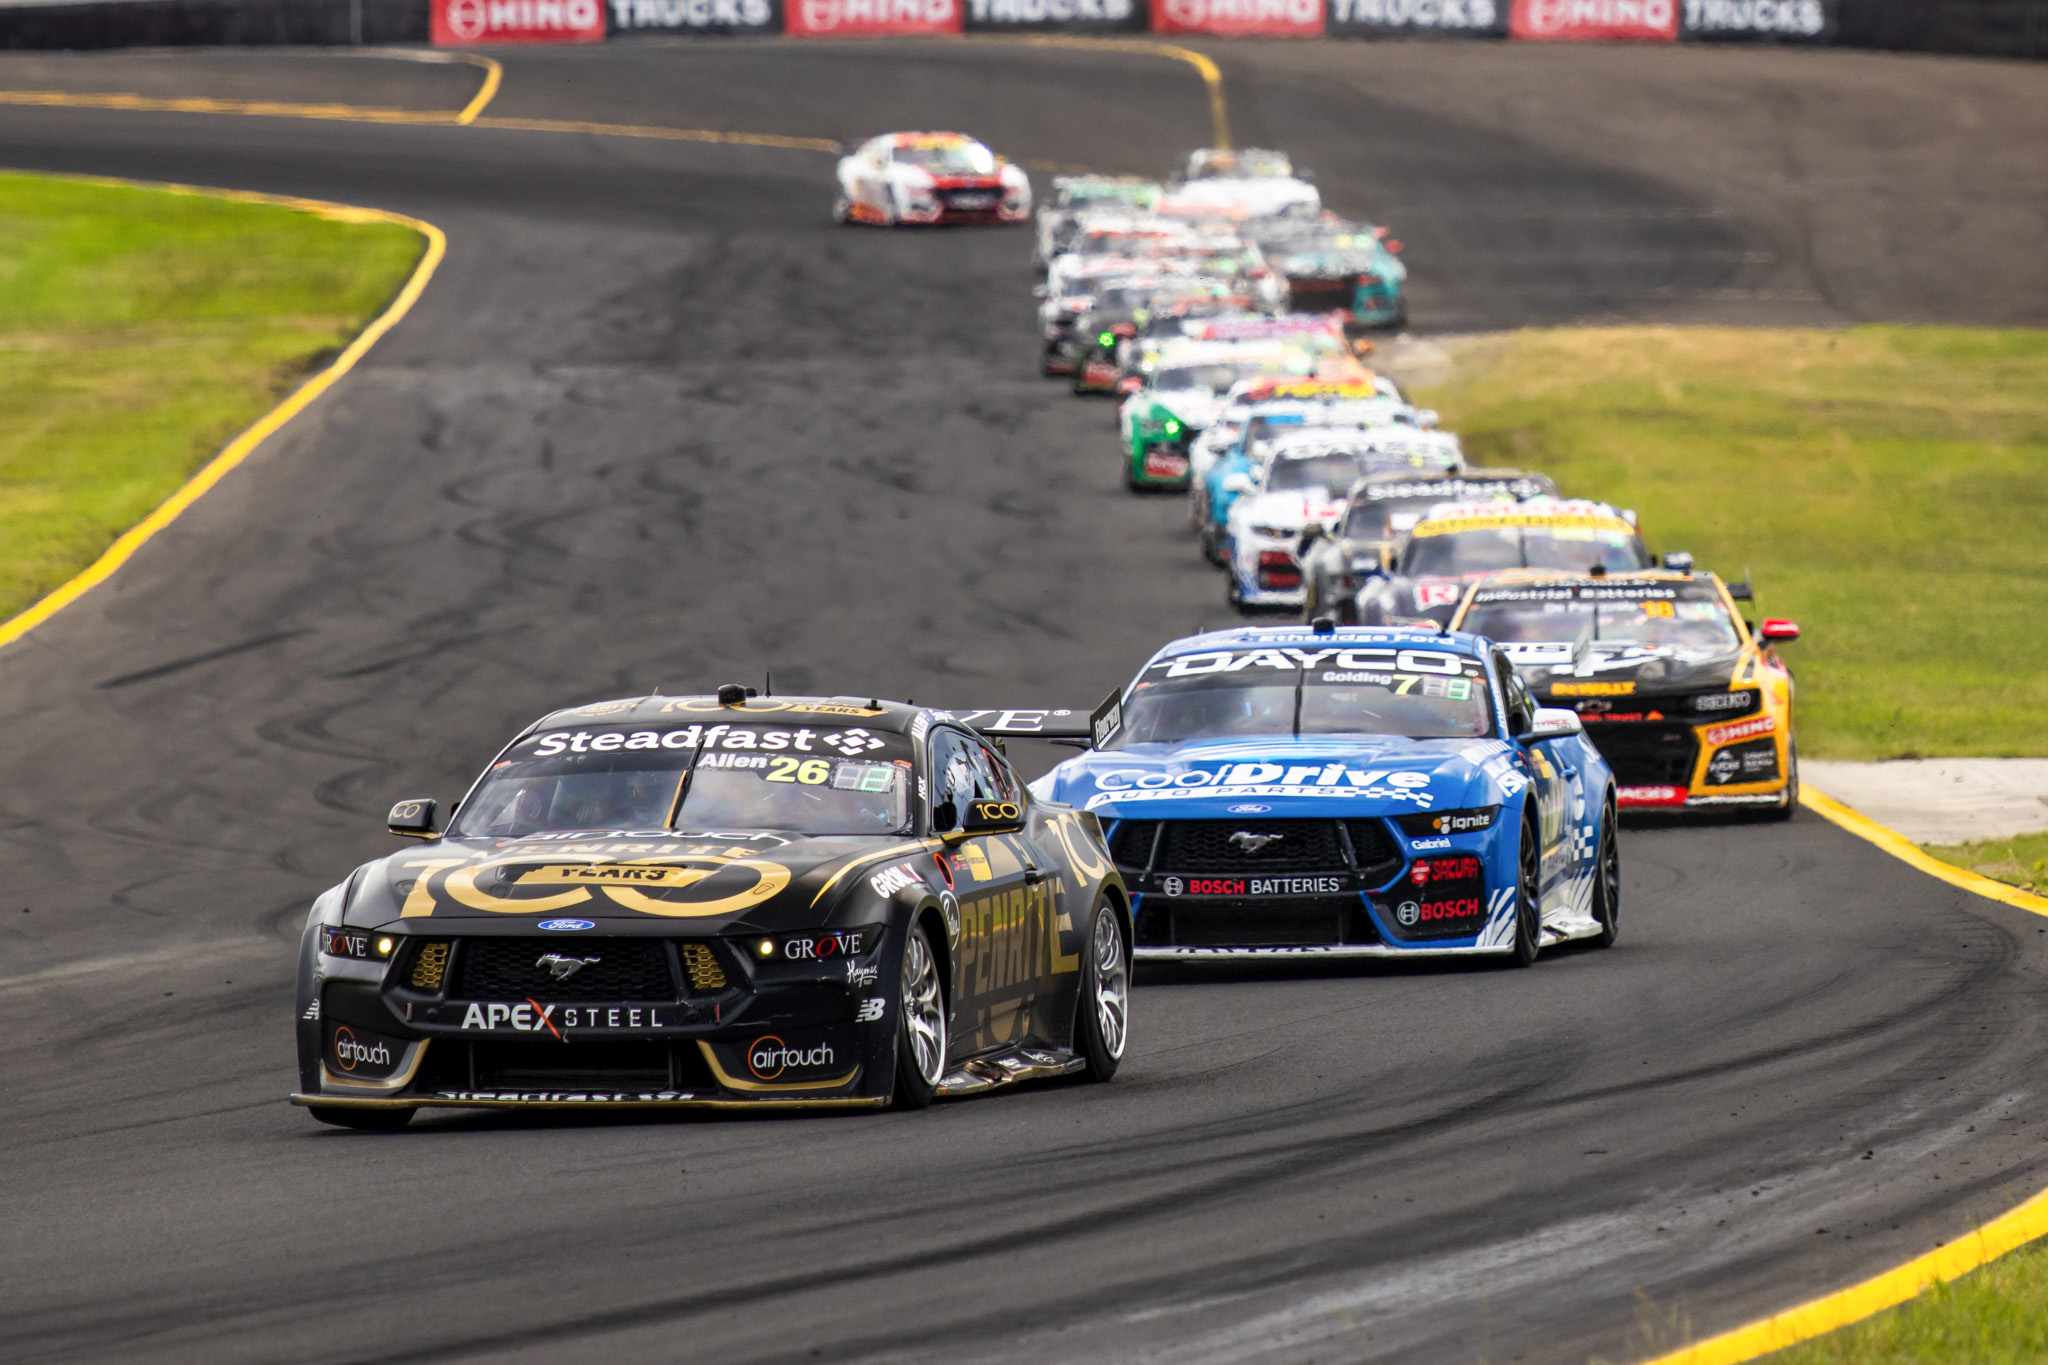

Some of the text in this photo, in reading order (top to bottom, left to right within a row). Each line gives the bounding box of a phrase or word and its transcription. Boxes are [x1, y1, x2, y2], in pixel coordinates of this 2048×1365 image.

[488, 0, 772, 29] HINO TRUCKS
[971, 0, 1132, 23] TRUCKS
[1333, 0, 1497, 28] TRUCKS
[1684, 0, 1824, 35] TRUCKS
[1640, 601, 1675, 618] 18
[1258, 634, 1388, 643] Etheridge
[1395, 634, 1455, 645] Ford
[1166, 648, 1464, 677] DAYCO
[1322, 670, 1393, 686] Golding
[1392, 674, 1420, 695] 7
[804, 705, 861, 714] YEARS
[533, 725, 817, 756] Steadfast
[697, 753, 768, 770] Allen
[765, 757, 830, 785] 26
[1095, 763, 1431, 789] CoolDrive
[1097, 787, 1338, 802] AUTO PARTS
[1452, 814, 1490, 830] ignite
[1411, 838, 1451, 850] Gabriel
[1189, 878, 1340, 894] BOSCH BATTERIES
[1421, 898, 1478, 921] BOSCH
[547, 920, 586, 930] Ford
[461, 998, 663, 1035] APEX STEEL
[337, 1037, 390, 1065] airtouch
[753, 1041, 834, 1069] airtouch
